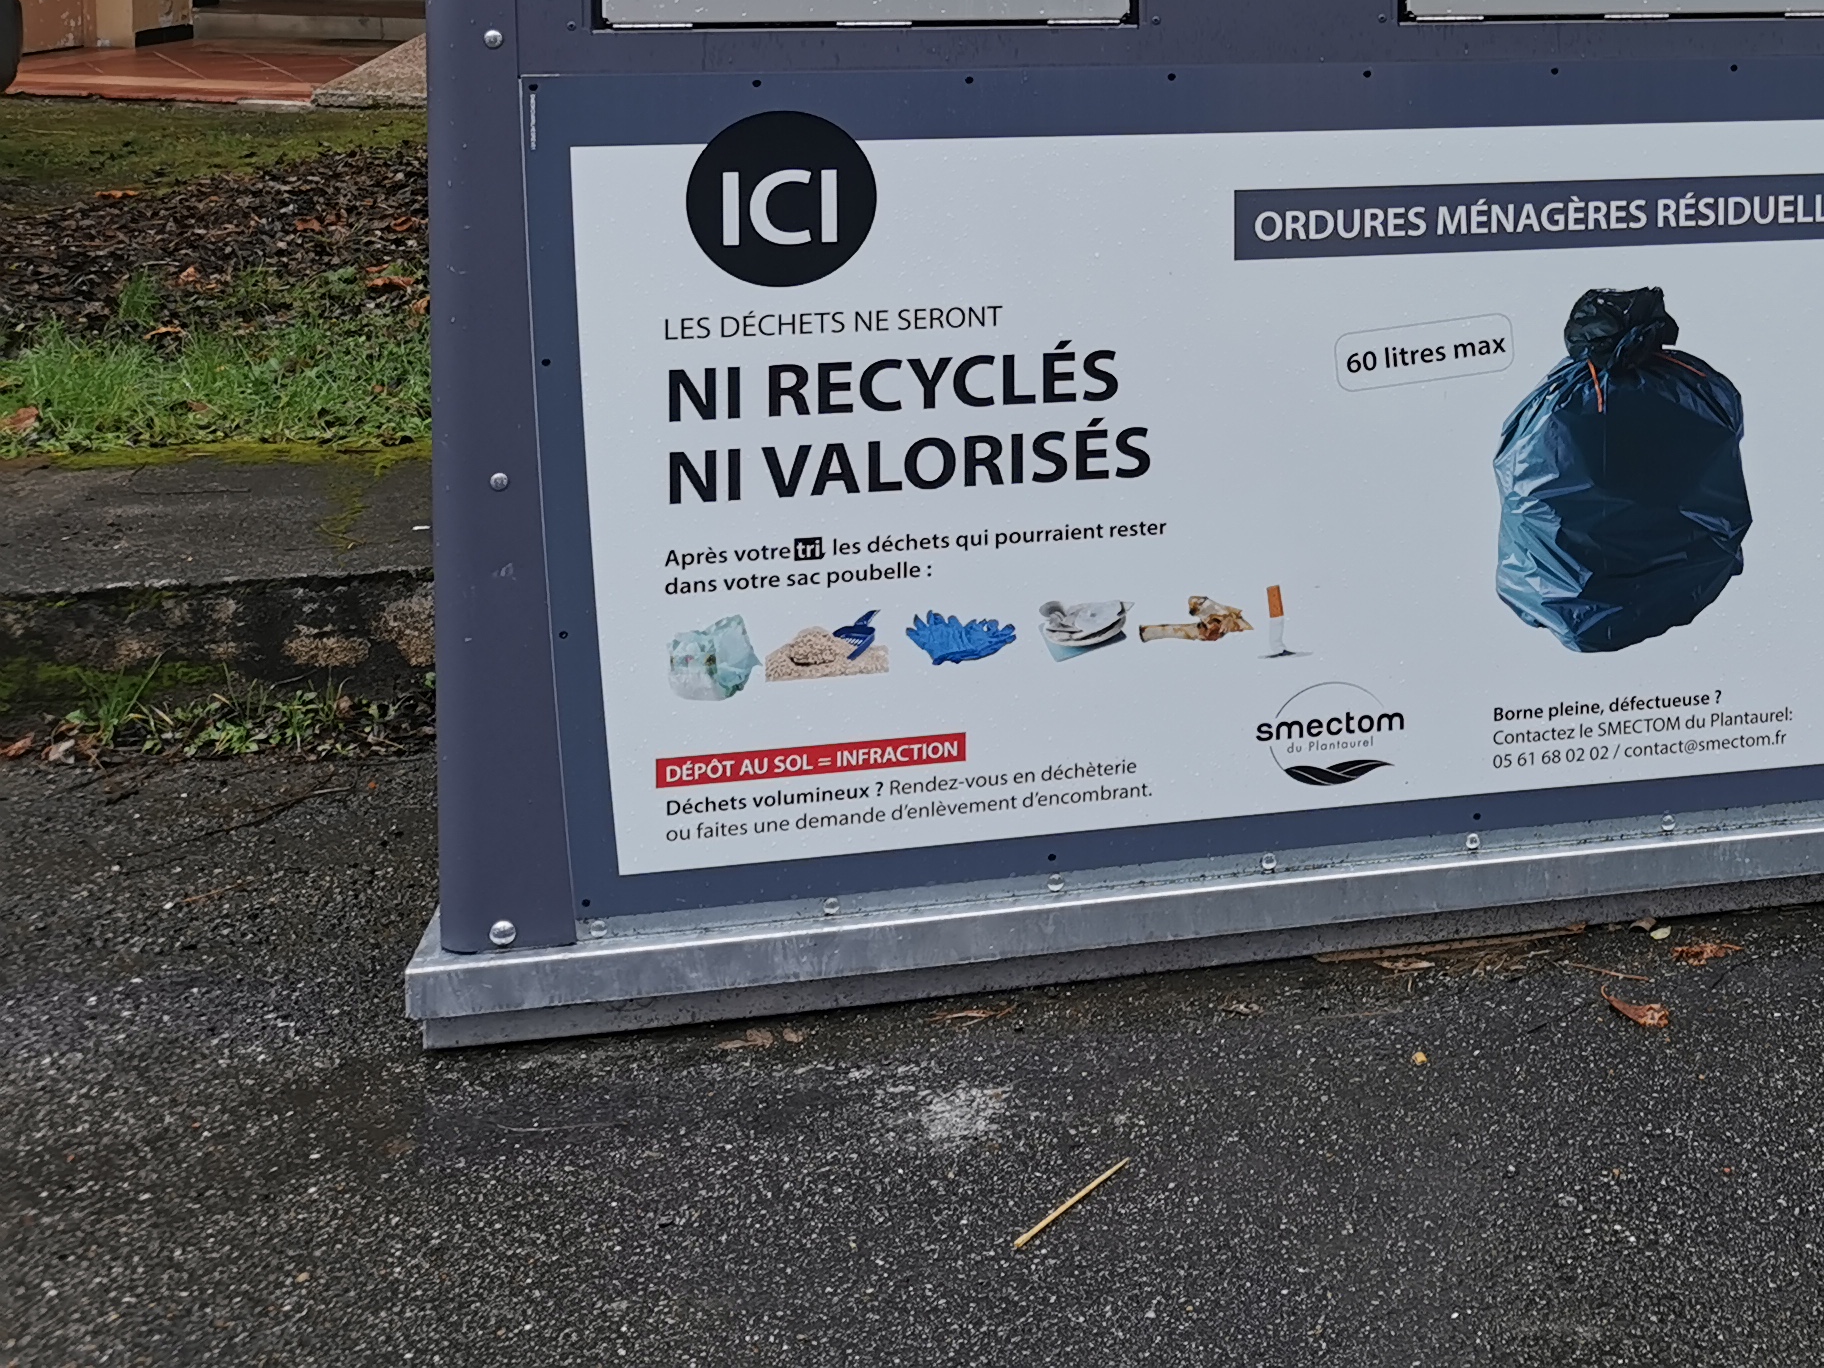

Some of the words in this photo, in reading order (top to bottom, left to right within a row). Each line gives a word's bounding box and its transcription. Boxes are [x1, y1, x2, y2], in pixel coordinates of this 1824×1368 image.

[722, 169, 838, 247] ICI
[1254, 205, 1427, 242] ORDURES
[1436, 195, 1648, 236] MÉNAGÈRES
[664, 316, 711, 341] LES
[720, 310, 845, 338] DÉCHETS
[854, 309, 889, 333] NE
[897, 305, 1003, 331] SERONT
[1346, 350, 1377, 374] 60
[1384, 345, 1447, 369] litres
[1453, 337, 1507, 360] max
[668, 366, 741, 423] NI
[768, 339, 1119, 418] RECYCLÉS
[669, 447, 741, 505] NI
[761, 417, 1151, 499] VALORISÉS
[664, 546, 728, 571] Après
[733, 545, 791, 562] votre
[833, 537, 861, 556] les
[867, 533, 950, 554] déchets
[955, 529, 989, 552] qui
[995, 523, 1104, 550] pourraient
[1109, 521, 1167, 538] rester
[664, 576, 718, 595] dans
[723, 573, 781, 591] votre
[786, 571, 821, 587] sac
[826, 561, 921, 589] poubelle
[927, 564, 932, 577] :
[1492, 727, 1576, 746] Contactez
[1579, 723, 1594, 739] le
[1597, 715, 1681, 737] SMECTOM
[1684, 714, 1706, 730] du
[1710, 706, 1793, 728] Plantaurel:
[1493, 707, 1544, 722] Borne
[1548, 700, 1605, 722] pleine,
[1608, 693, 1711, 713] défectueuse
[1714, 689, 1722, 705] ?
[1255, 711, 1405, 748] smectom
[1286, 741, 1303, 754] du
[1308, 735, 1374, 752] Plantaurel
[1492, 753, 1513, 769] 05
[1517, 751, 1535, 767] 61
[1541, 749, 1562, 765] 68
[1565, 747, 1585, 763] 02
[1589, 745, 1609, 761] 02
[1612, 743, 1621, 760] /
[1623, 729, 1787, 759] contact@smectom.fr
[665, 757, 736, 783] DÉPÔT
[739, 757, 769, 777] AU
[773, 753, 814, 773] SOL
[817, 757, 832, 767] =
[836, 740, 958, 768] INFRACTION
[666, 795, 747, 817] Déchets
[752, 786, 870, 809] volumineux
[875, 781, 884, 797] ?
[889, 773, 1009, 796] Rendez-vous
[1013, 771, 1036, 785] en
[1040, 759, 1137, 782] déchèterie
[665, 828, 691, 842] ou
[696, 821, 748, 839] faites
[753, 819, 790, 834] une
[795, 806, 887, 830] demande
[891, 795, 1018, 821] d'enlèvement
[1021, 783, 1153, 809] d'encombrant.
